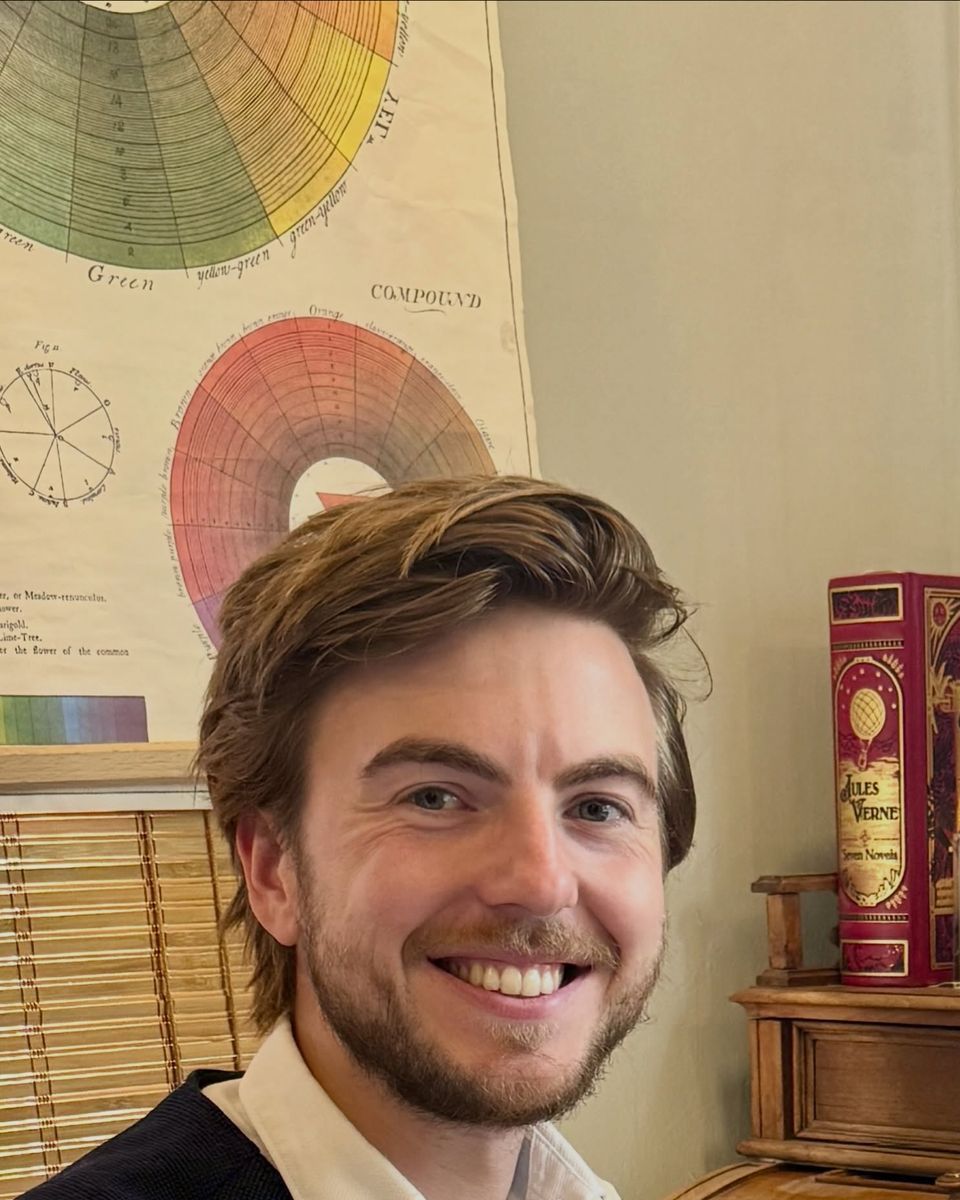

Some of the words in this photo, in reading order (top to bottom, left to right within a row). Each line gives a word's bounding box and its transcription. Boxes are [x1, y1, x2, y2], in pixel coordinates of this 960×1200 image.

[289, 180, 349, 260] green-yellow
[87, 264, 154, 292] Green
[197, 248, 271, 290] yellow-green
[370, 283, 482, 309] COMPOUND
[15, 645, 28, 655] the
[62, 645, 72, 656] of
[79, 645, 91, 656] the
[97, 647, 130, 657] common
[840, 774, 880, 803] JULES
[849, 798, 901, 824] VERNE
